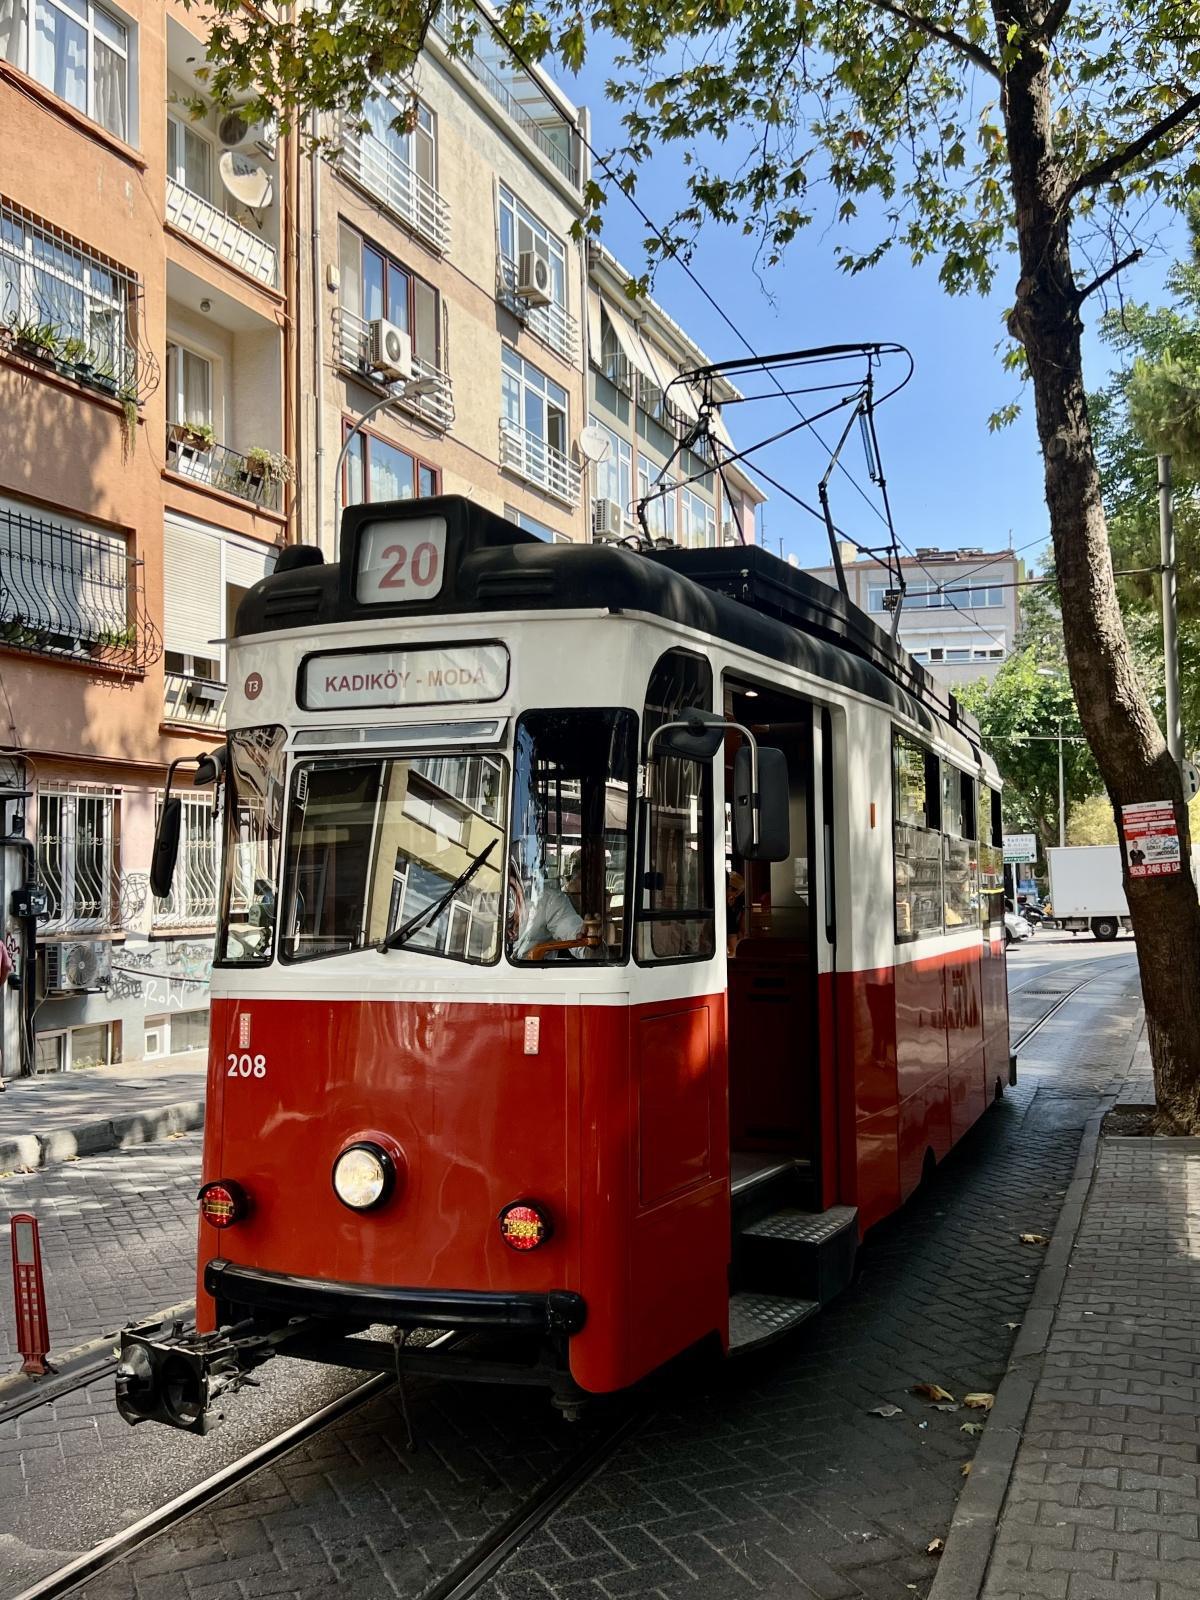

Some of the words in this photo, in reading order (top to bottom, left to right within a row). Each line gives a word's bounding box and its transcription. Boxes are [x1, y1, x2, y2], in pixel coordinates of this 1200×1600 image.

[378, 542, 438, 589] 20
[247, 680, 259, 692] T3
[325, 669, 411, 692] KADIKÖY
[428, 667, 486, 687] MODA
[227, 1053, 266, 1078] 208
